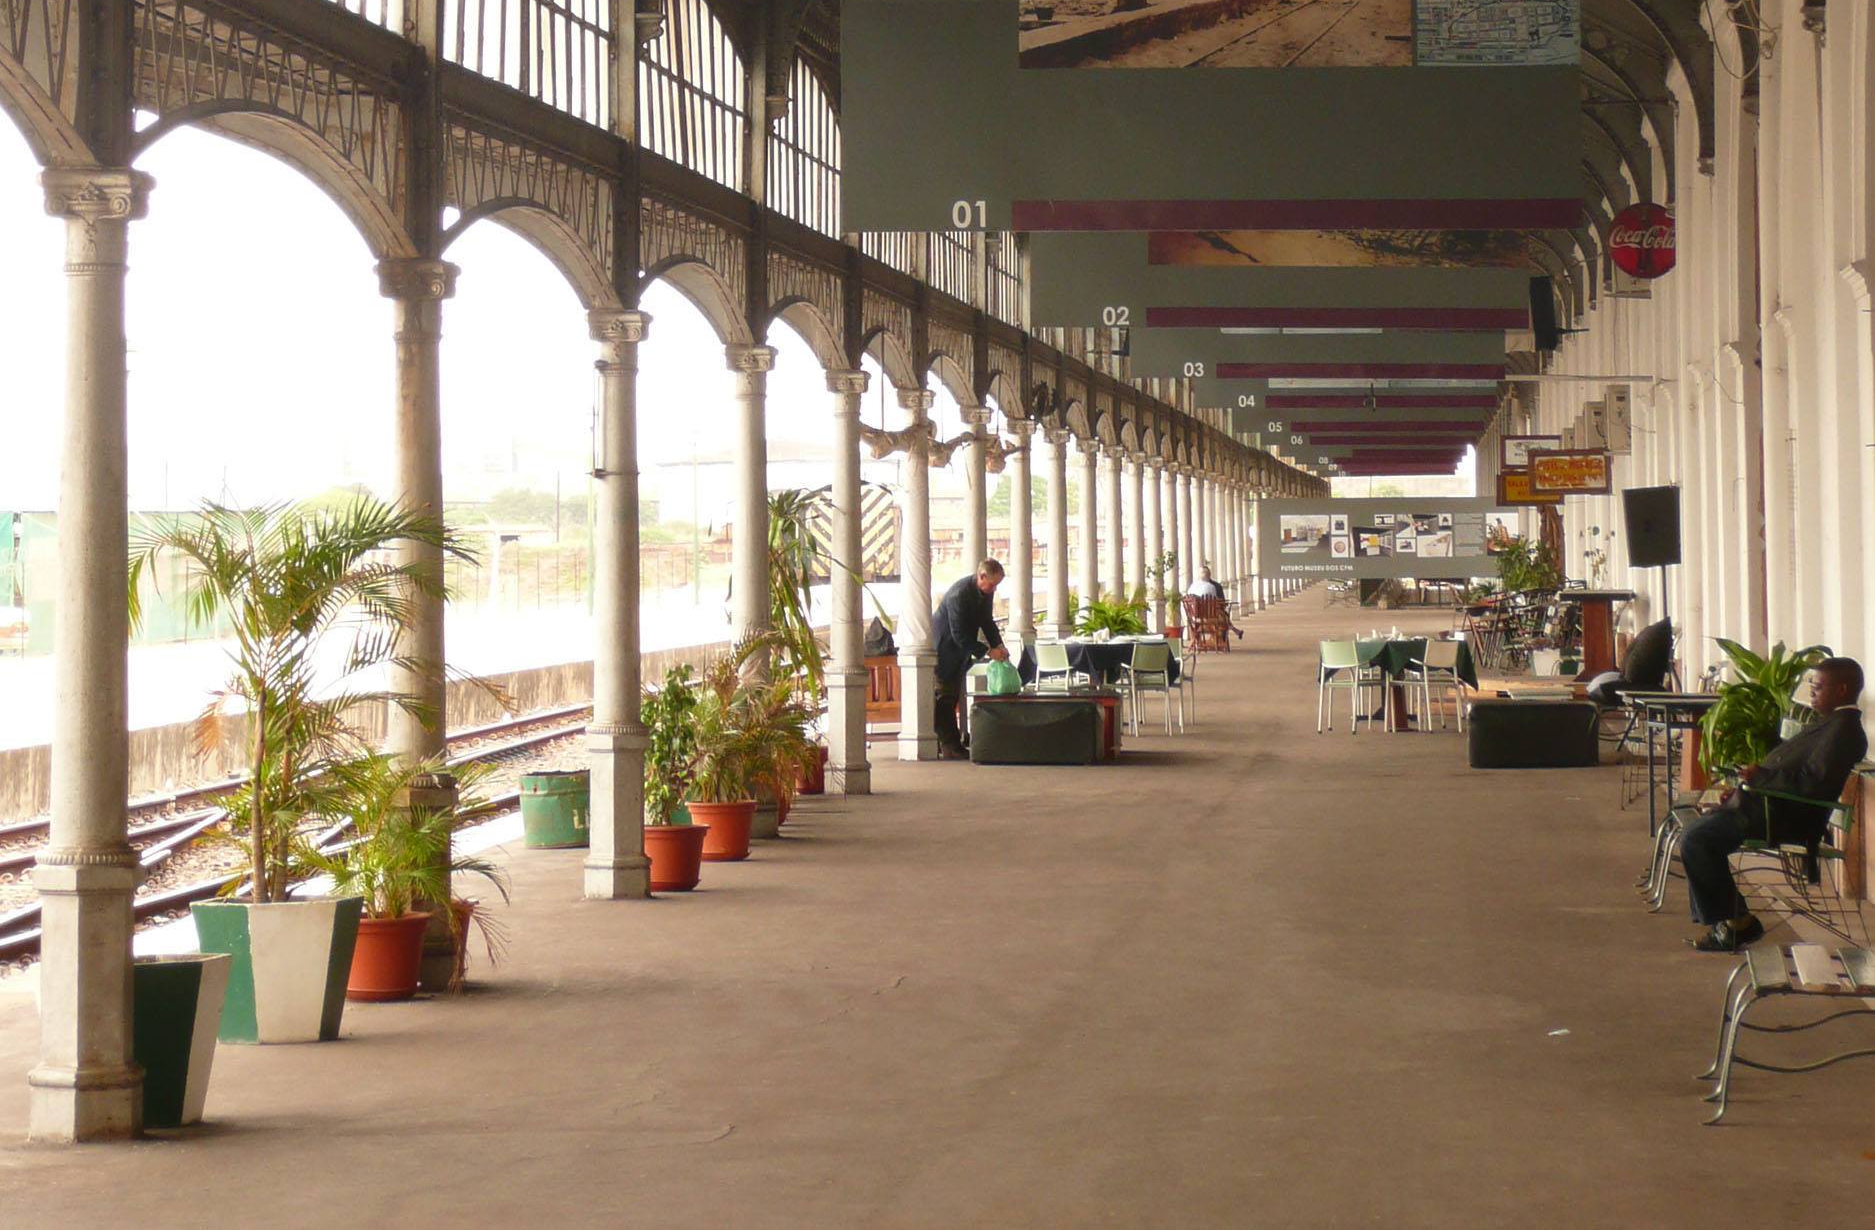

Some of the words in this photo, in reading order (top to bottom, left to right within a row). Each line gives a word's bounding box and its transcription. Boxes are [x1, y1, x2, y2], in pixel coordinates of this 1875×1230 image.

[953, 200, 987, 228] 01
[1103, 306, 1130, 326] 02
[1184, 362, 1204, 378] 03
[1238, 394, 1255, 408] 04
[1268, 421, 1282, 432] 05
[1291, 435, 1303, 445] 06
